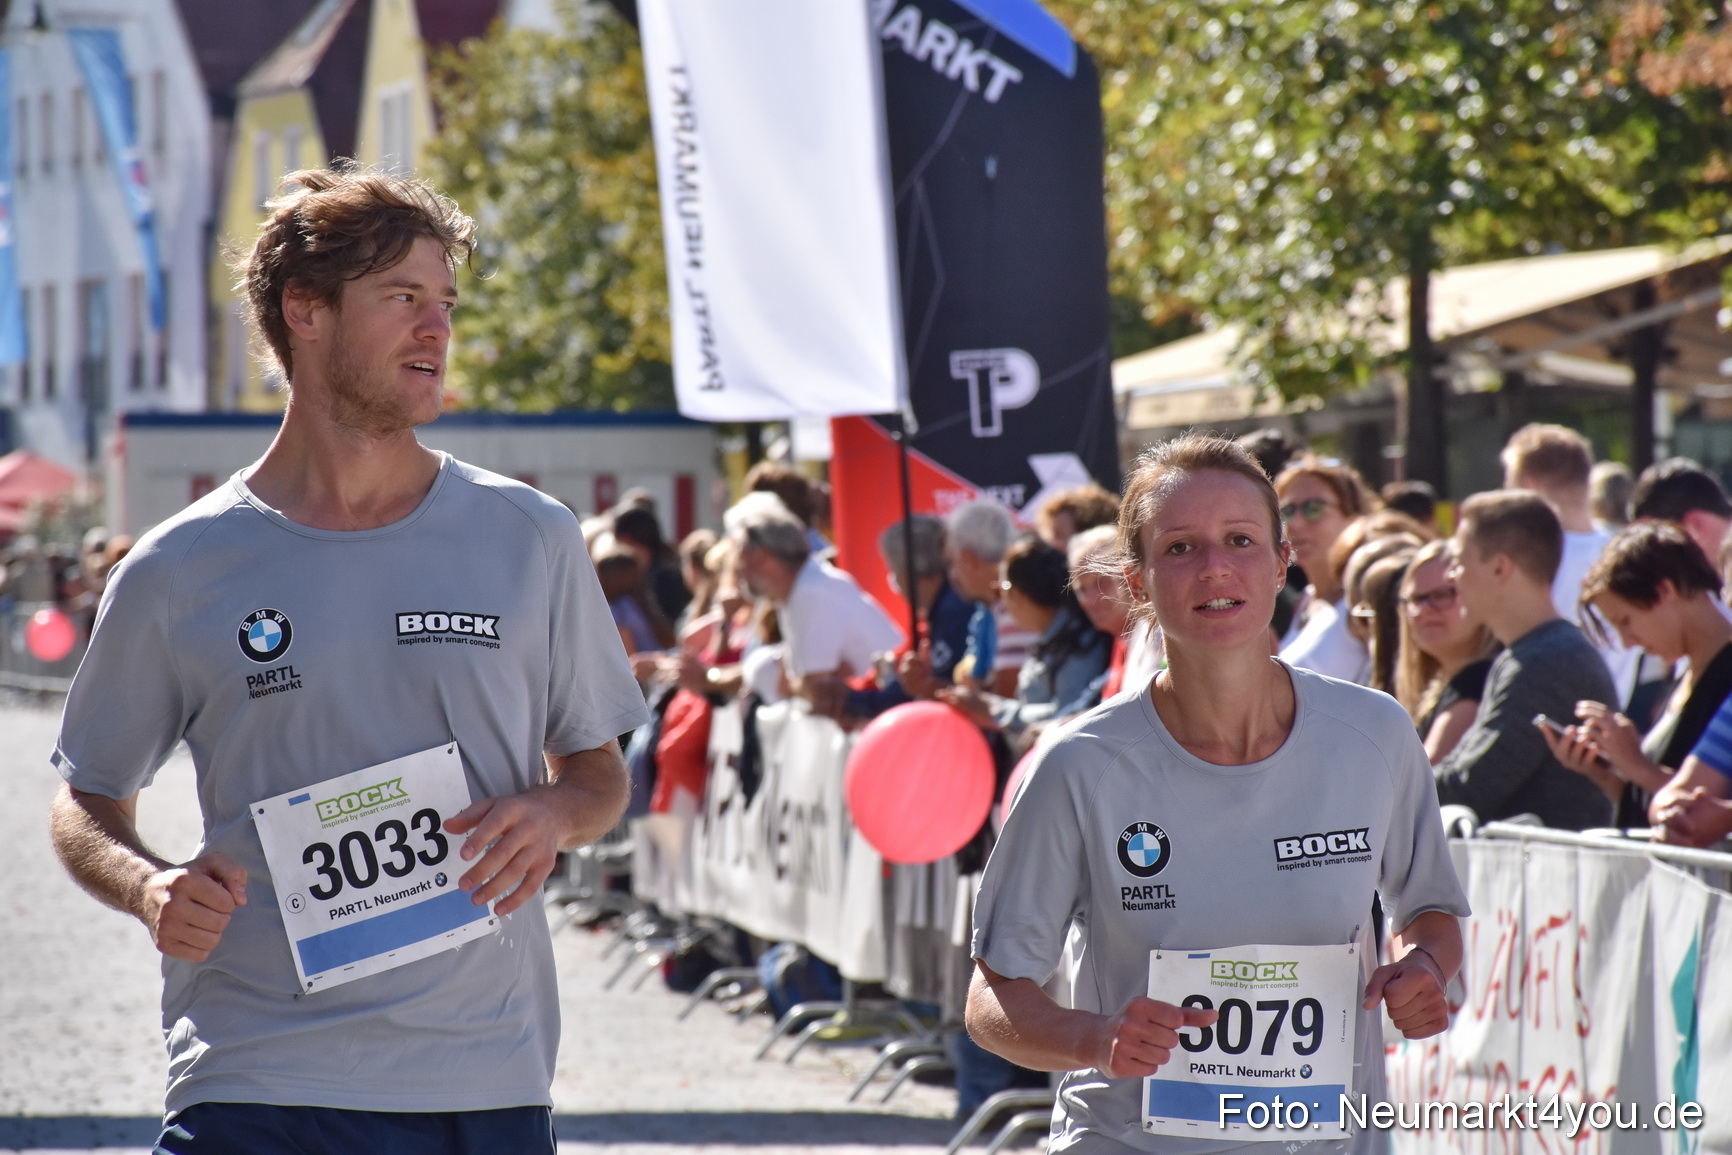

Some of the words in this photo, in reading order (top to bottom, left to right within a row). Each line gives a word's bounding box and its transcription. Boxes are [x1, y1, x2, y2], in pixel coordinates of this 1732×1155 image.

[241, 610, 285, 632] BMW
[396, 611, 500, 640] BOCK
[397, 636, 431, 646] inspired
[433, 635, 443, 644] by
[469, 639, 500, 649] concepts
[246, 665, 301, 690] PARTL
[248, 679, 303, 700] Neumarkt
[315, 777, 408, 822] BOCK
[321, 816, 349, 829] inspired
[349, 813, 358, 821] by
[359, 808, 379, 818] smart
[380, 798, 411, 811] concepts
[1121, 823, 1166, 842] BMW
[302, 807, 449, 901] 3033
[1273, 827, 1372, 862] BOCK
[1277, 860, 1311, 871] inspired
[1312, 859, 1322, 867] by
[1324, 857, 1346, 865] smart
[1347, 854, 1372, 863] concepts
[328, 900, 373, 921] PARTL
[373, 879, 432, 907] Neumarkt
[1121, 884, 1175, 900] PARTL
[1122, 899, 1176, 911] Neumarkt
[1211, 960, 1299, 982] BOCK
[1210, 979, 1238, 988] inspired
[1239, 981, 1248, 990] by
[1270, 981, 1299, 989] concepts
[1178, 994, 1324, 1056] 3079
[1190, 1062, 1233, 1076] PARTL
[1236, 1065, 1296, 1079] Neumarkt
